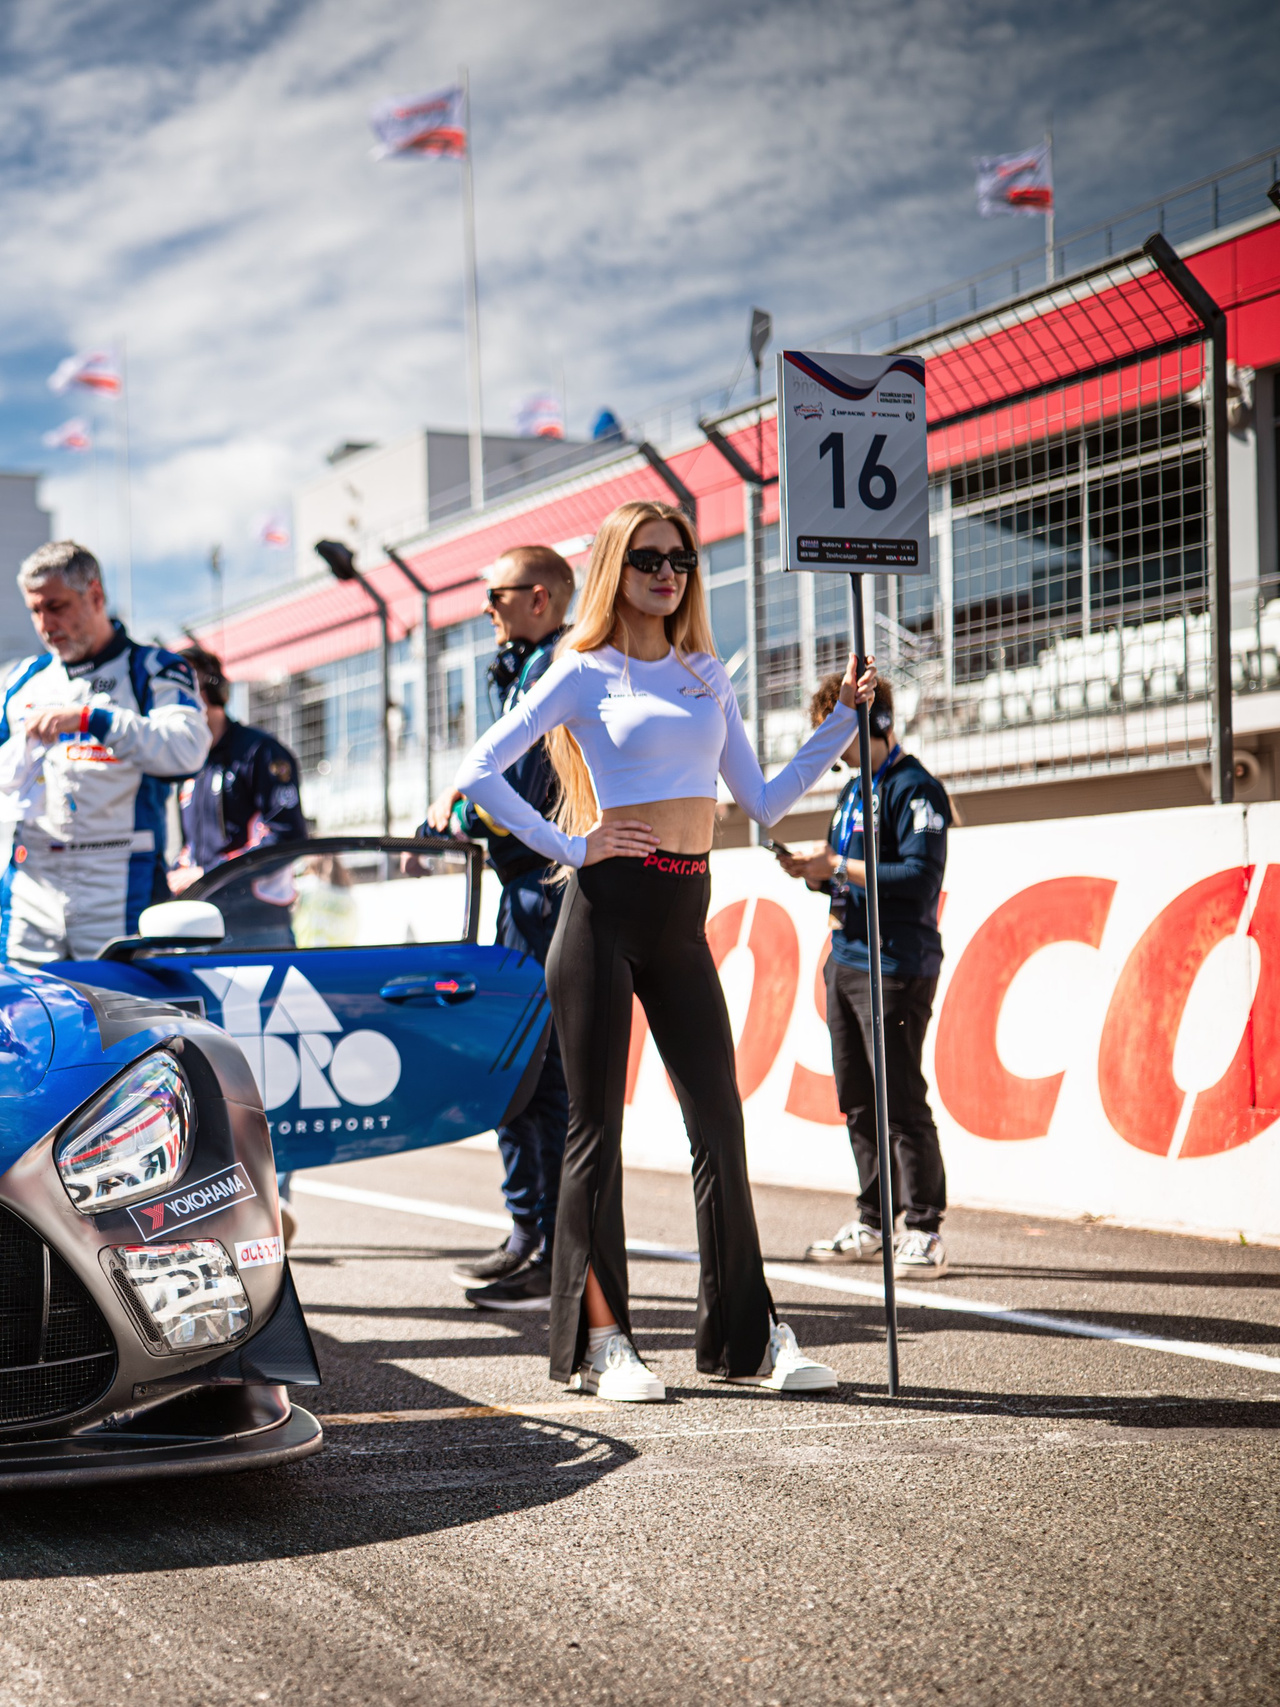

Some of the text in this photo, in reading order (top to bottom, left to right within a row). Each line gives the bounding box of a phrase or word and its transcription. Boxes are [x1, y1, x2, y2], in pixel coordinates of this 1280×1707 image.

[819, 431, 897, 511] 16
[643, 854, 707, 875] РСКГ.РФ
[165, 1174, 246, 1217] YOKOHAMA
